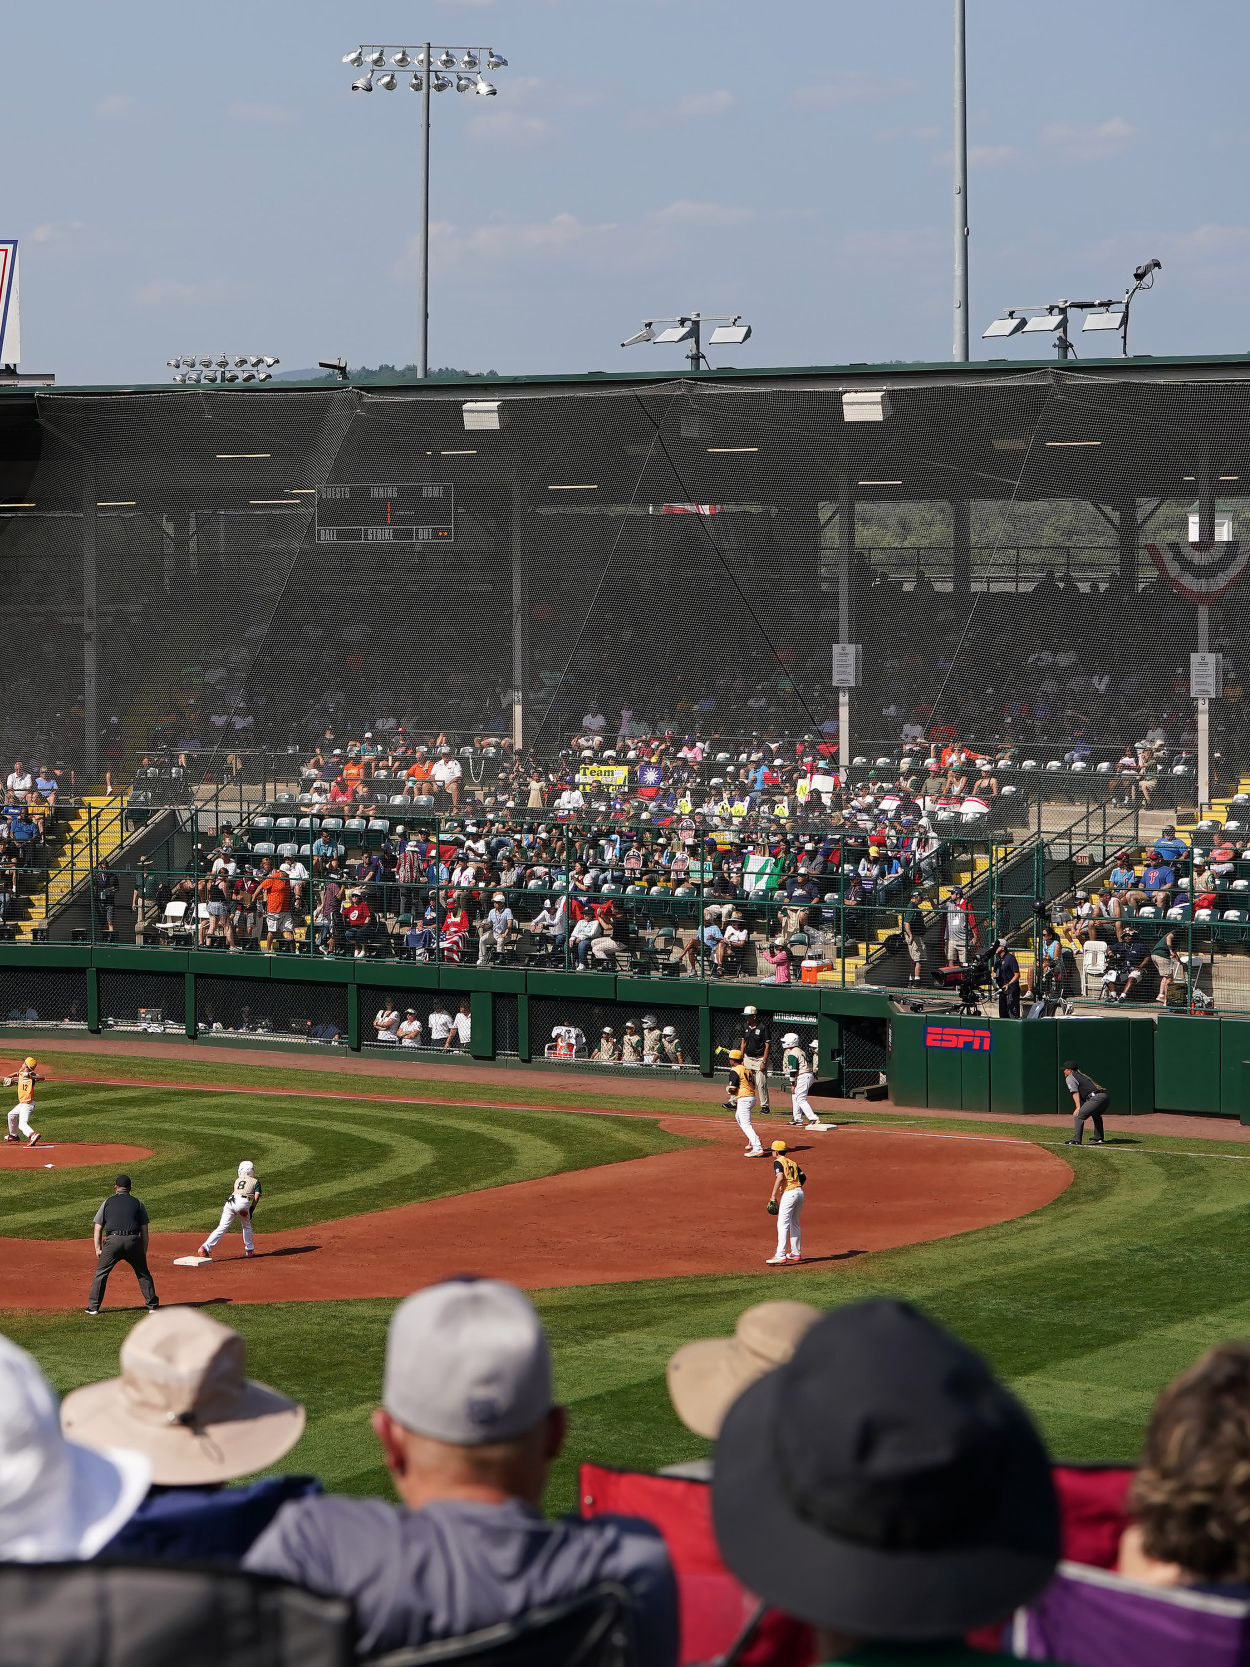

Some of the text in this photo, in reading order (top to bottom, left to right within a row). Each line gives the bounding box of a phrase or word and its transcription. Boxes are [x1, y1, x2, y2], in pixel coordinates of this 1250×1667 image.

[320, 529, 432, 541] BALL STRIKE OUT
[581, 766, 615, 777] Team
[926, 1026, 991, 1050] ESPN
[237, 1180, 247, 1190] 8
